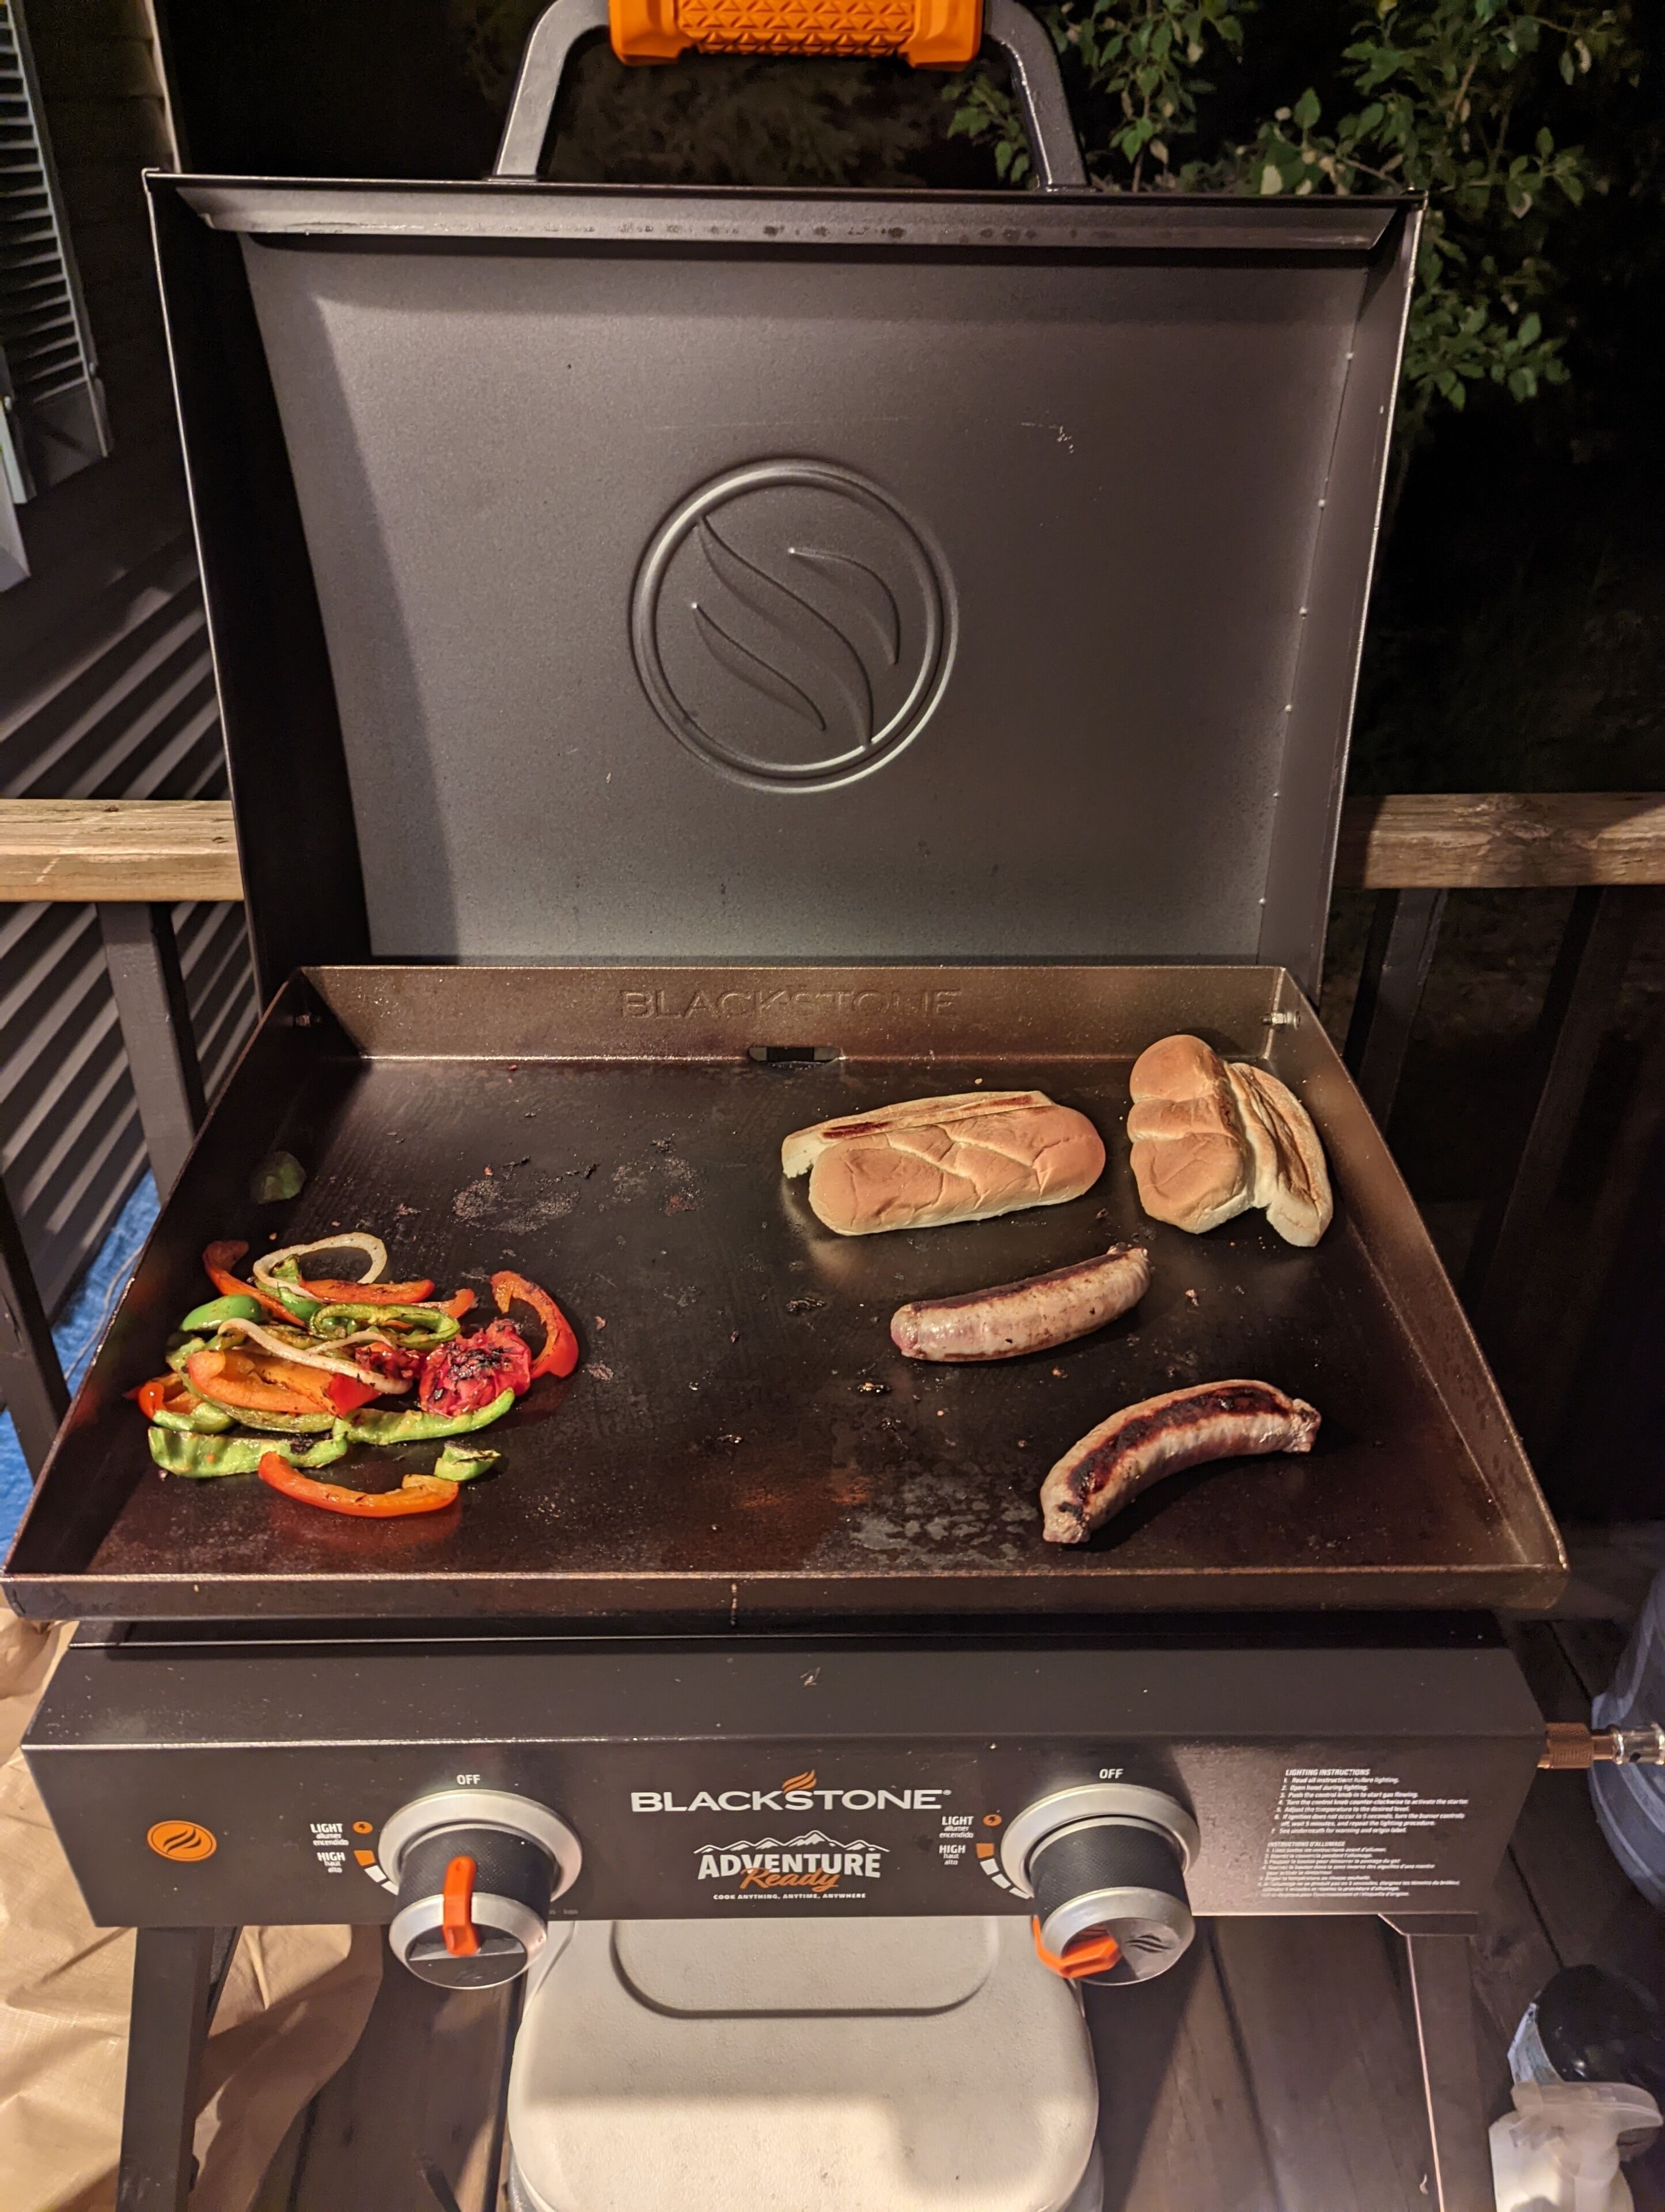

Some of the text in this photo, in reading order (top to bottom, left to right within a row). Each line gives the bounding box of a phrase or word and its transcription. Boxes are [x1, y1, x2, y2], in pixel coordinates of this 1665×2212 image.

[620, 988, 963, 1019] BLACKSTONE
[1099, 1768, 1124, 1779] OFF
[457, 1774, 481, 1785] OFF
[631, 1790, 943, 1812] BLACKSTONE
[942, 1816, 974, 1825] LIGHT
[310, 1823, 343, 1833] LIGHT
[939, 1845, 966, 1854] HIGH
[317, 1852, 346, 1861] HIGH
[697, 1854, 881, 1880] ADVENTURE
[739, 1868, 840, 1892] Ready
